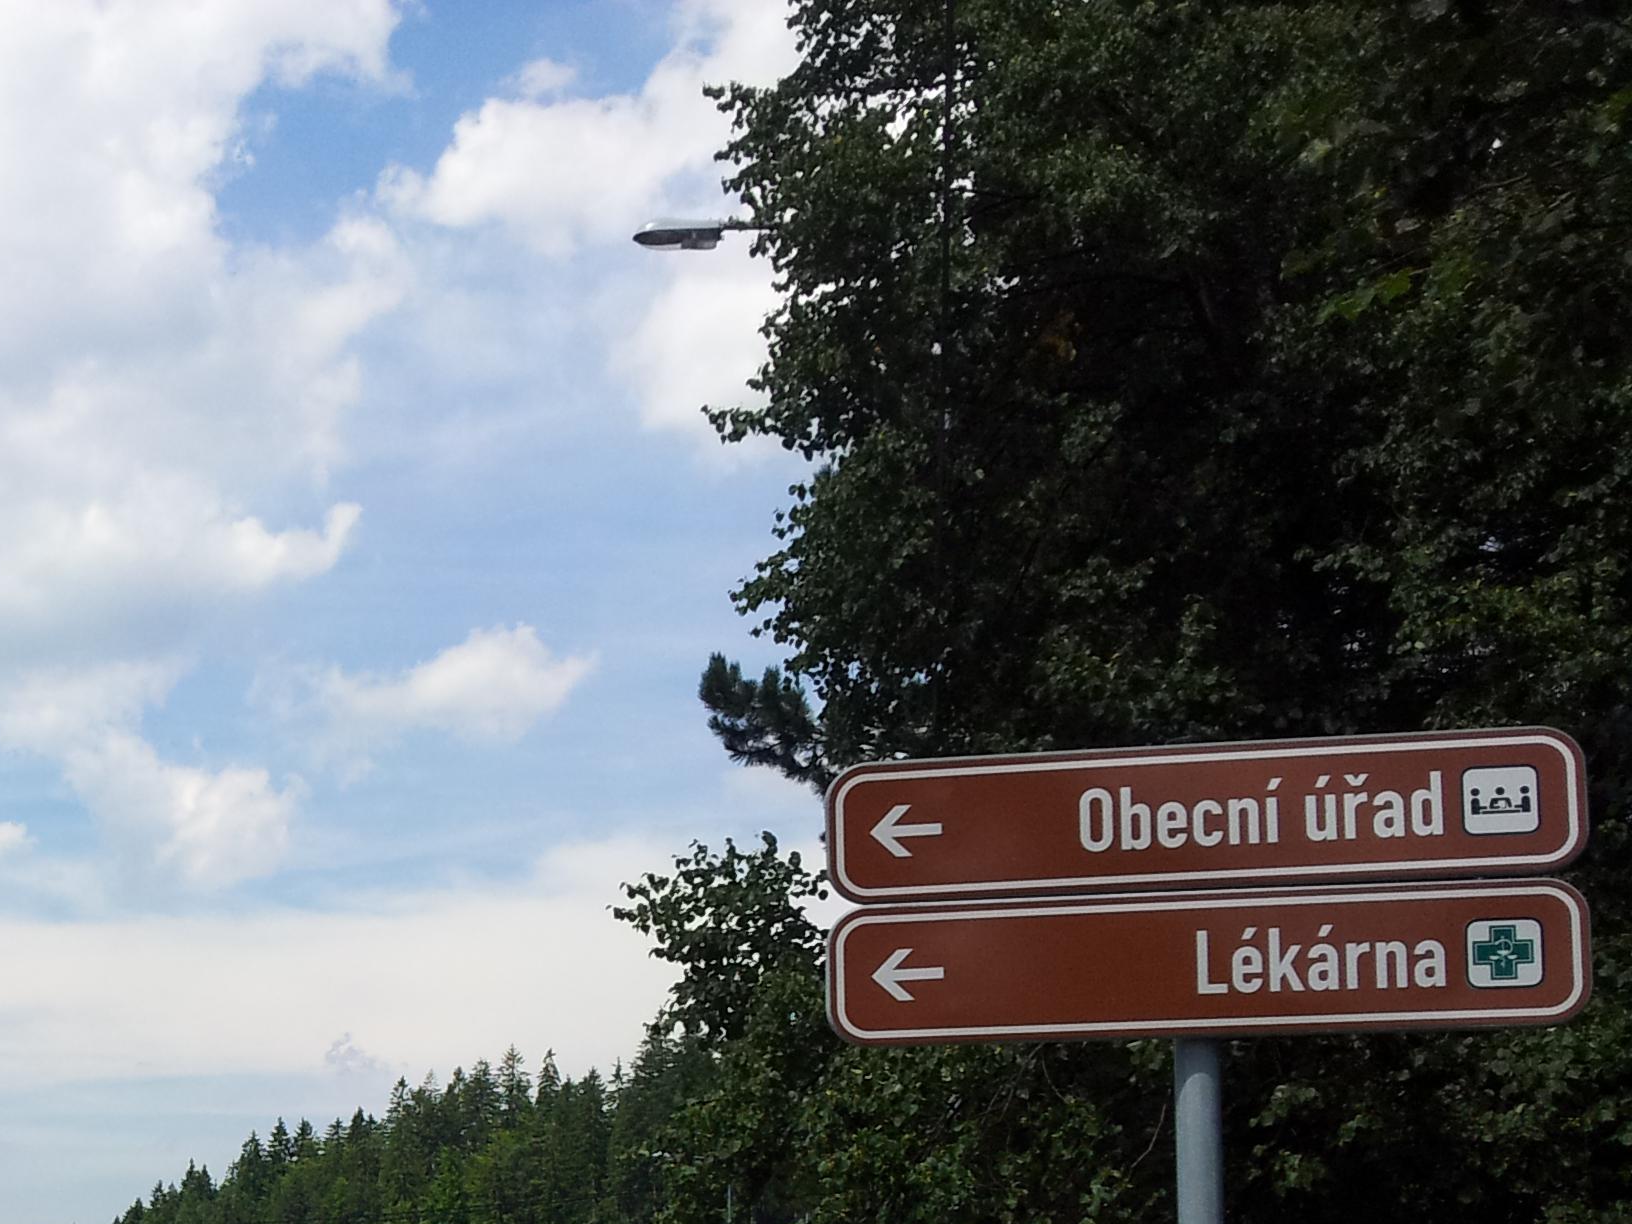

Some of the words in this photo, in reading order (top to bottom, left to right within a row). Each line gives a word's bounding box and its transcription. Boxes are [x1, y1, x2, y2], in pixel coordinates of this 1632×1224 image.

[1079, 777, 1282, 853] Obecní
[1304, 770, 1445, 841] úřad
[1195, 924, 1447, 995] Lékárna
